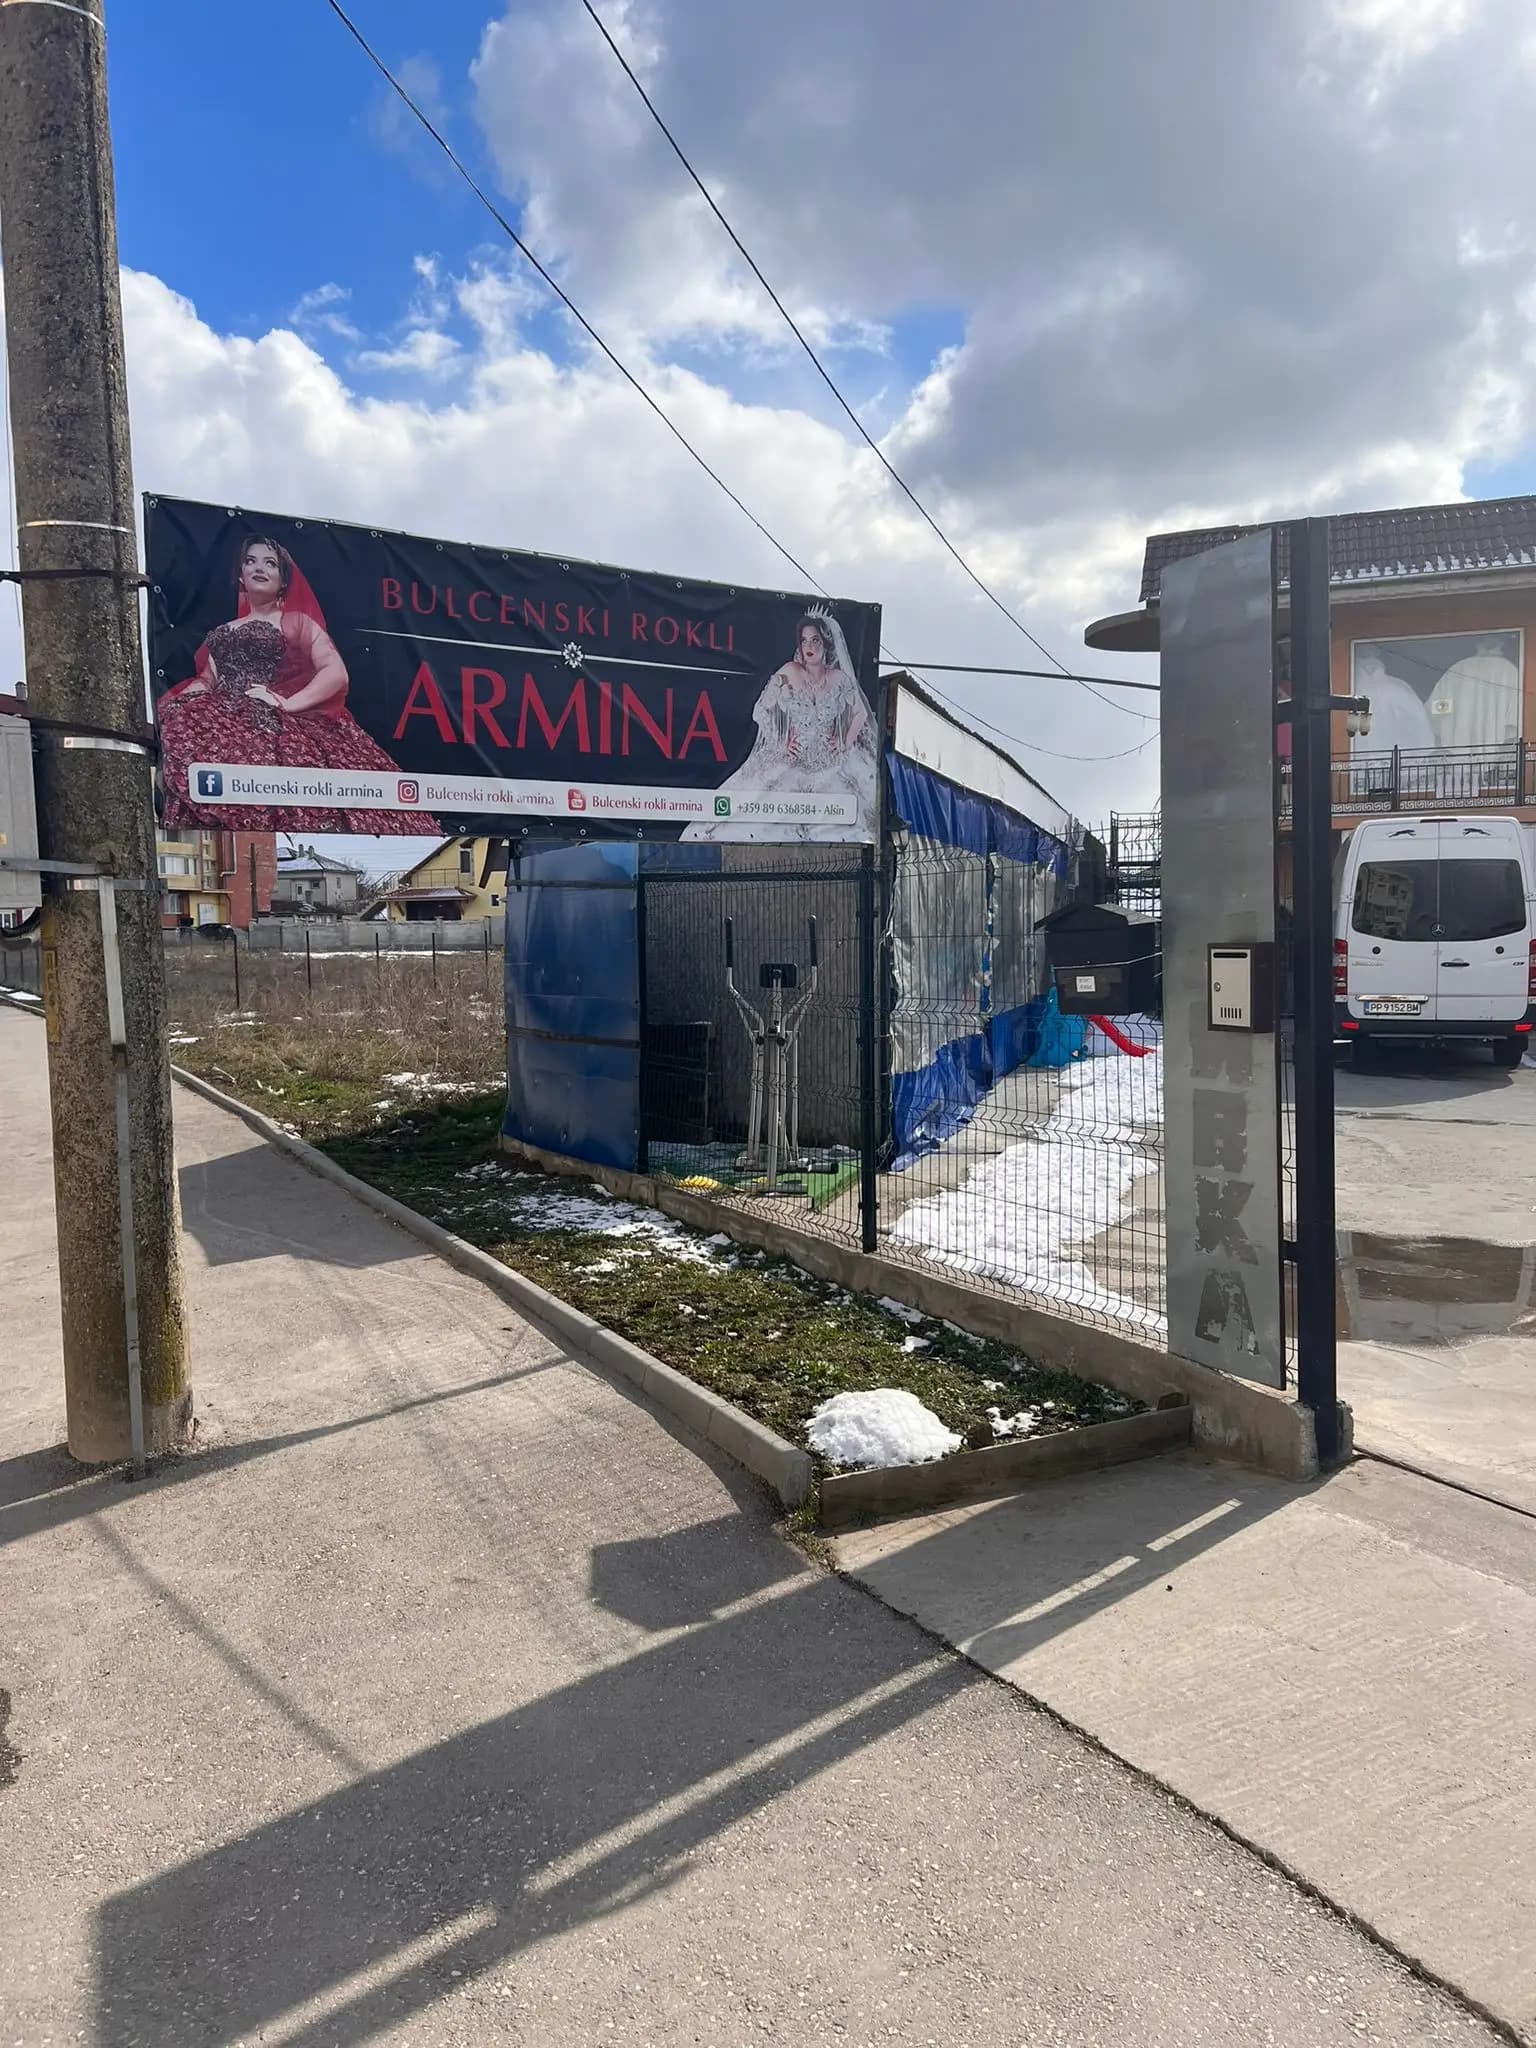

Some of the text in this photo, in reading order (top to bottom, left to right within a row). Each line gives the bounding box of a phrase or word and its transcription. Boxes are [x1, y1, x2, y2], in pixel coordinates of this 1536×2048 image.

[382, 577, 733, 652] BULCENSKI ROKLI
[393, 661, 728, 762] ARMINA
[231, 778, 383, 798] Bulcenski rokli armina
[426, 786, 483, 801] Bulcenski
[487, 789, 513, 803] rokli
[516, 794, 555, 806] armina
[592, 795, 641, 809] Bulcenski
[644, 798, 666, 810] rokli
[669, 800, 703, 812] armina
[737, 802, 760, 814] +359
[762, 803, 775, 814] 89
[777, 804, 816, 816] 6368584
[823, 804, 845, 816] Alsin
[1370, 1003, 1383, 1012] PP
[1384, 1003, 1406, 1012] 9152
